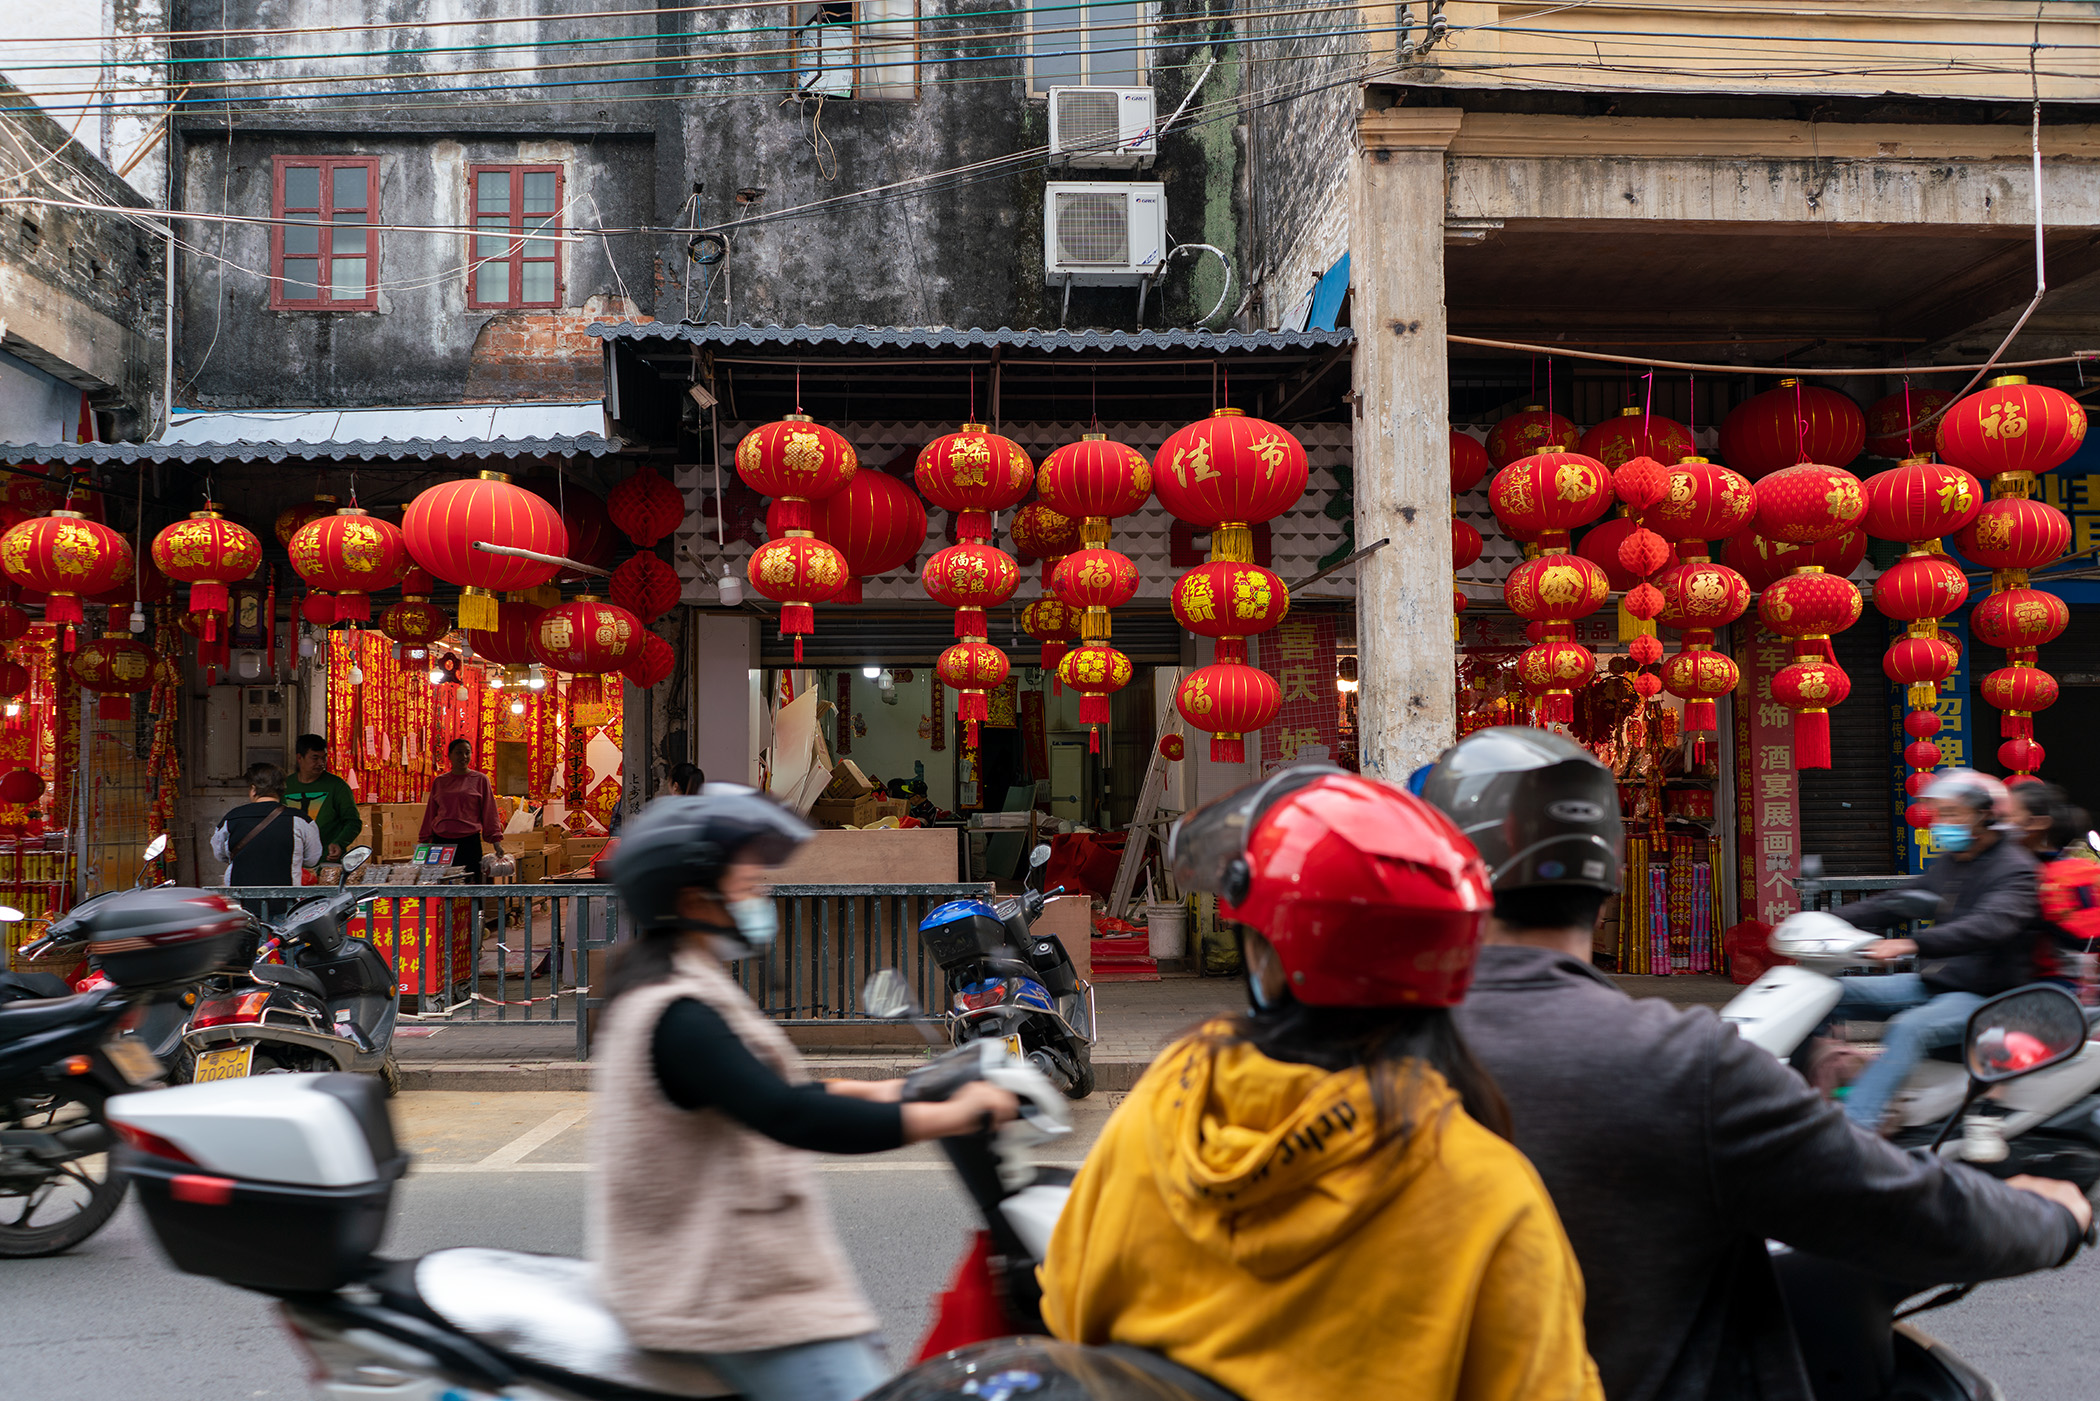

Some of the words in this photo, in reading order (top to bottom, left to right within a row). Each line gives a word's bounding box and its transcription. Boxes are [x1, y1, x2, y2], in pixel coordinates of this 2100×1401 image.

[1981, 401, 2028, 440] 福
[783, 432, 824, 471] 福
[1171, 433, 1290, 488] 佳节
[1131, 455, 1152, 492] 福
[1718, 470, 1751, 521] 吉祥
[1825, 477, 1862, 520] 福
[1936, 475, 1973, 514] 福
[760, 545, 796, 584] 福
[806, 546, 842, 586] 福
[1077, 558, 1113, 590] 福
[1691, 572, 1724, 600] 福
[541, 613, 573, 651] 福
[114, 652, 148, 679] 福
[1276, 622, 1319, 702] 喜庆
[1182, 678, 1213, 715] 福
[1798, 671, 1830, 699] 福
[1891, 704, 1904, 756] 宣传单
[597, 786, 619, 812] 福
[1759, 745, 1793, 854] 酒宴展画
[1893, 765, 1905, 816] 不干胶
[1742, 855, 1755, 901] 横额
[199, 1063, 244, 1083] 7020R
